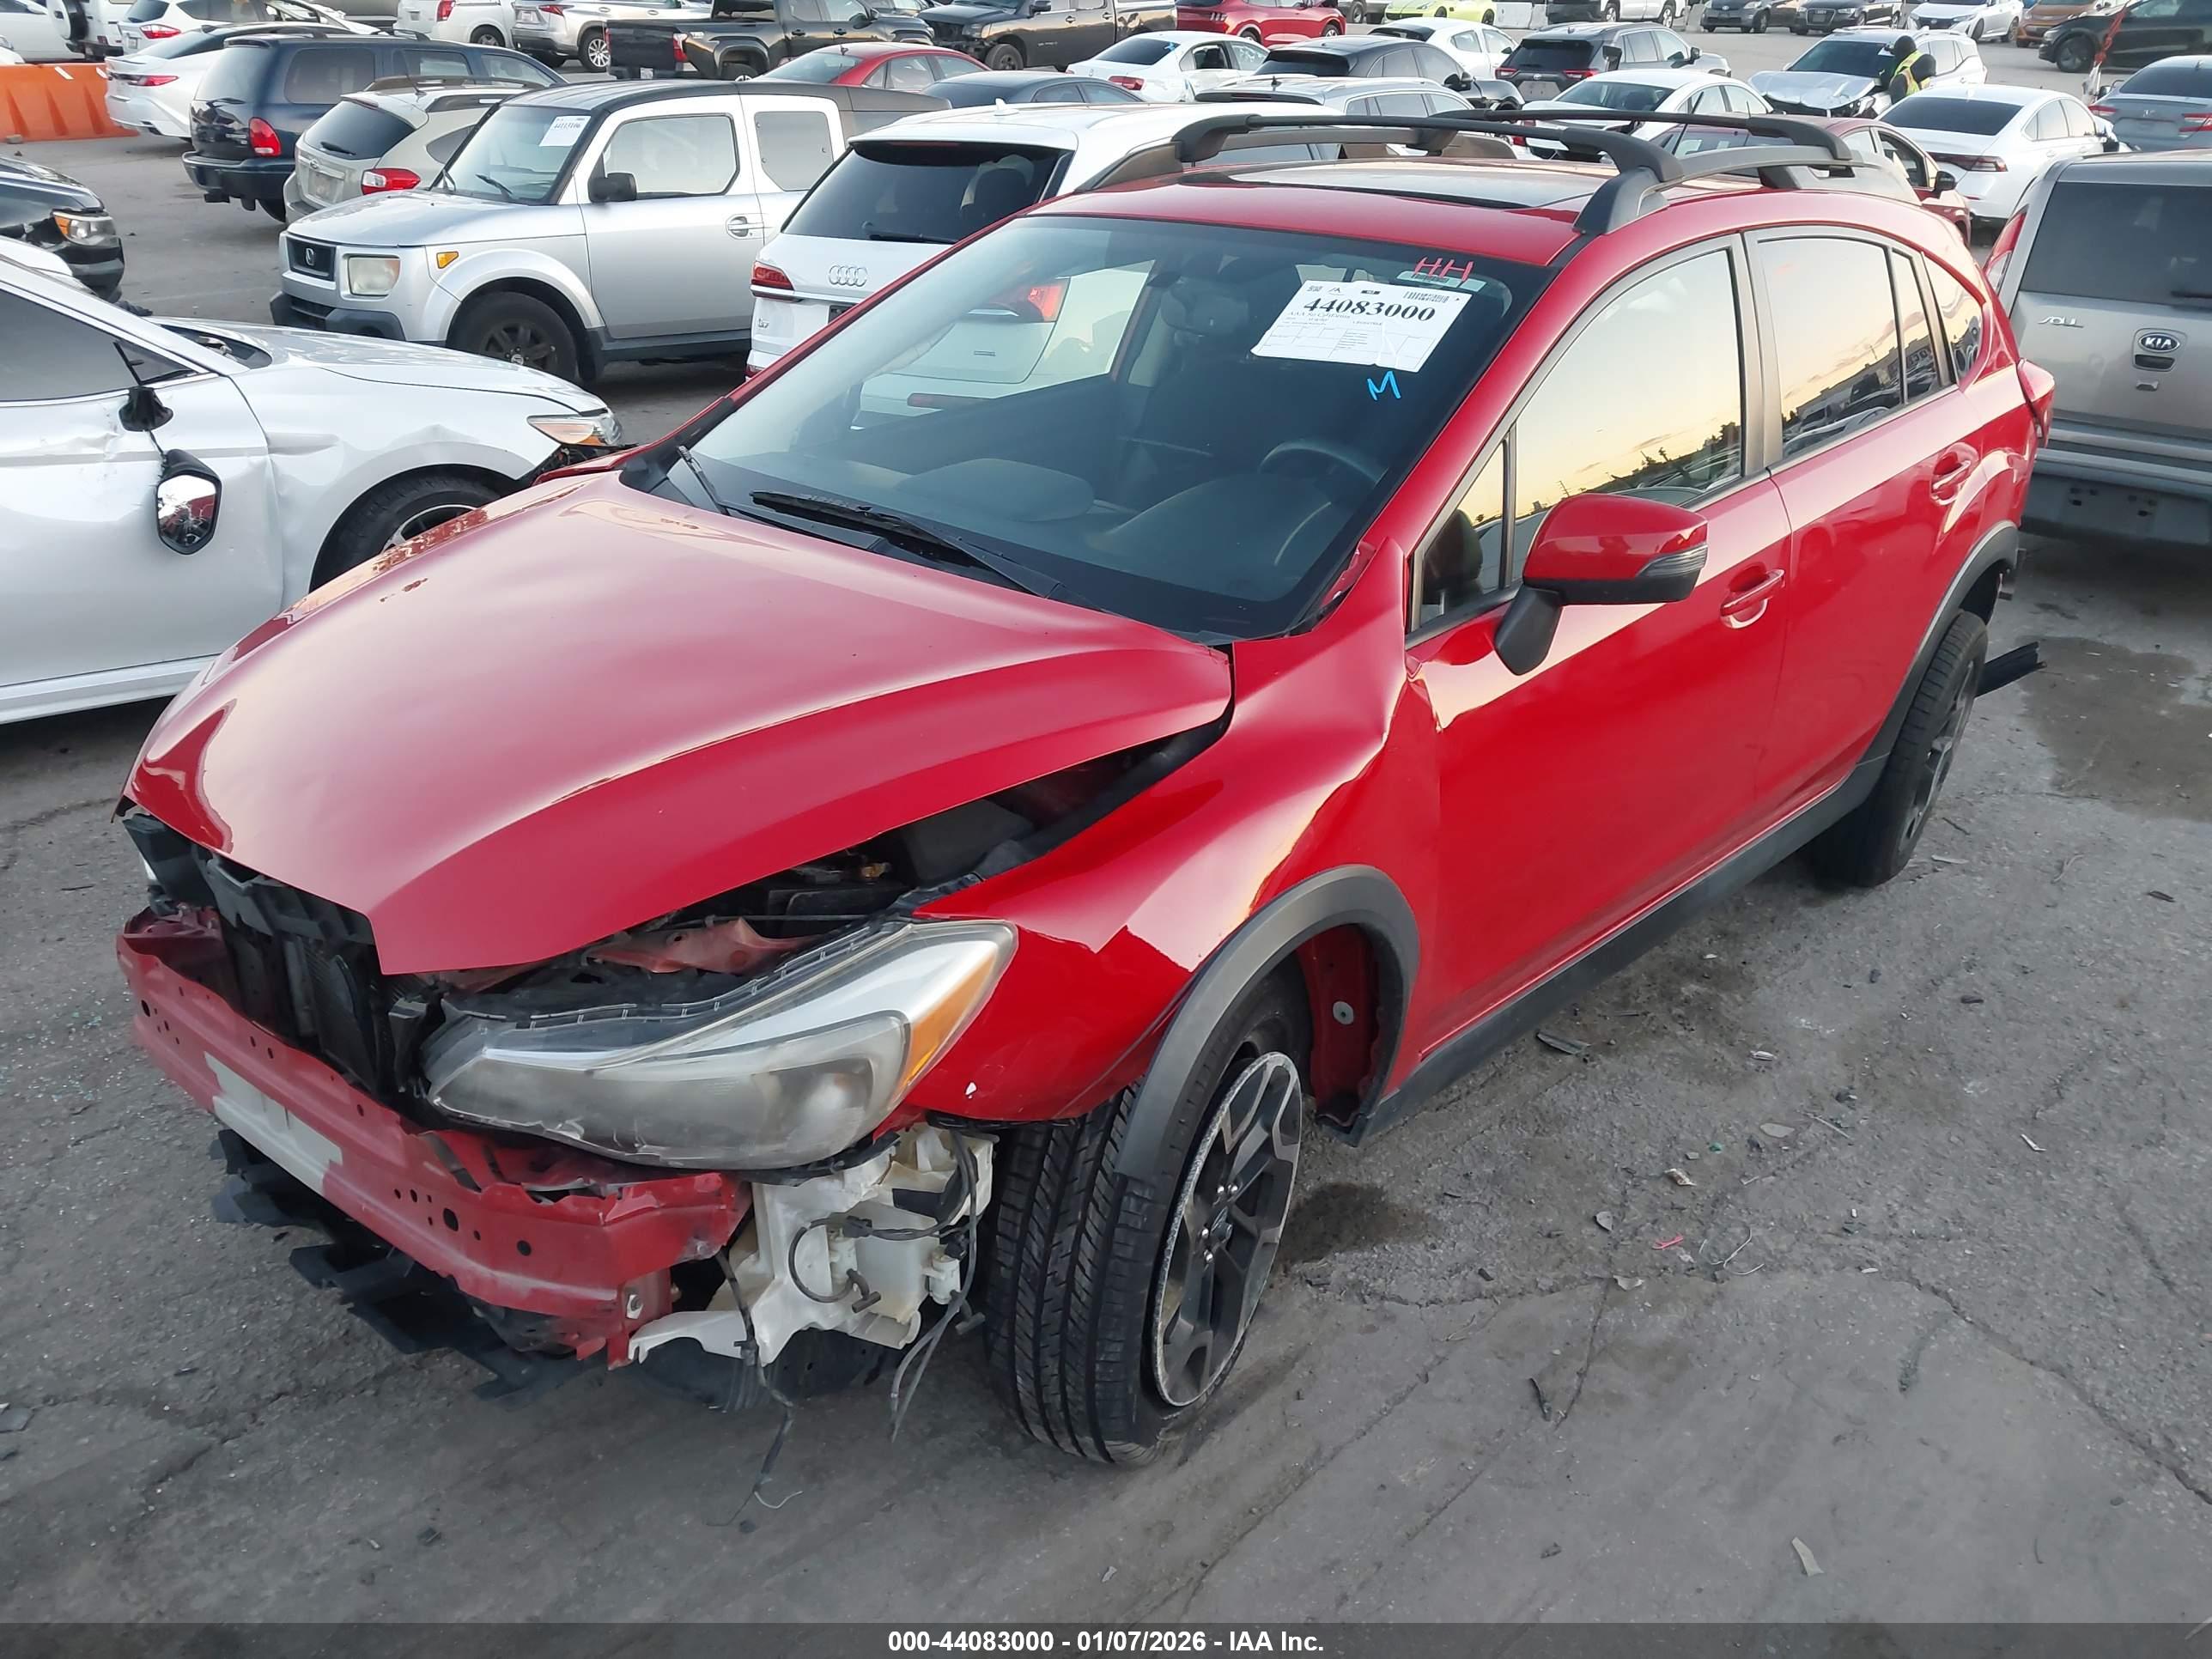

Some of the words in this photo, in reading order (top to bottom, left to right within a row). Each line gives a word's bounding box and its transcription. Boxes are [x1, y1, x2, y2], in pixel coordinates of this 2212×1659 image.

[1304, 297, 1437, 321] 44083000
[2144, 337, 2172, 349] KIA
[1366, 371, 1401, 401] M
